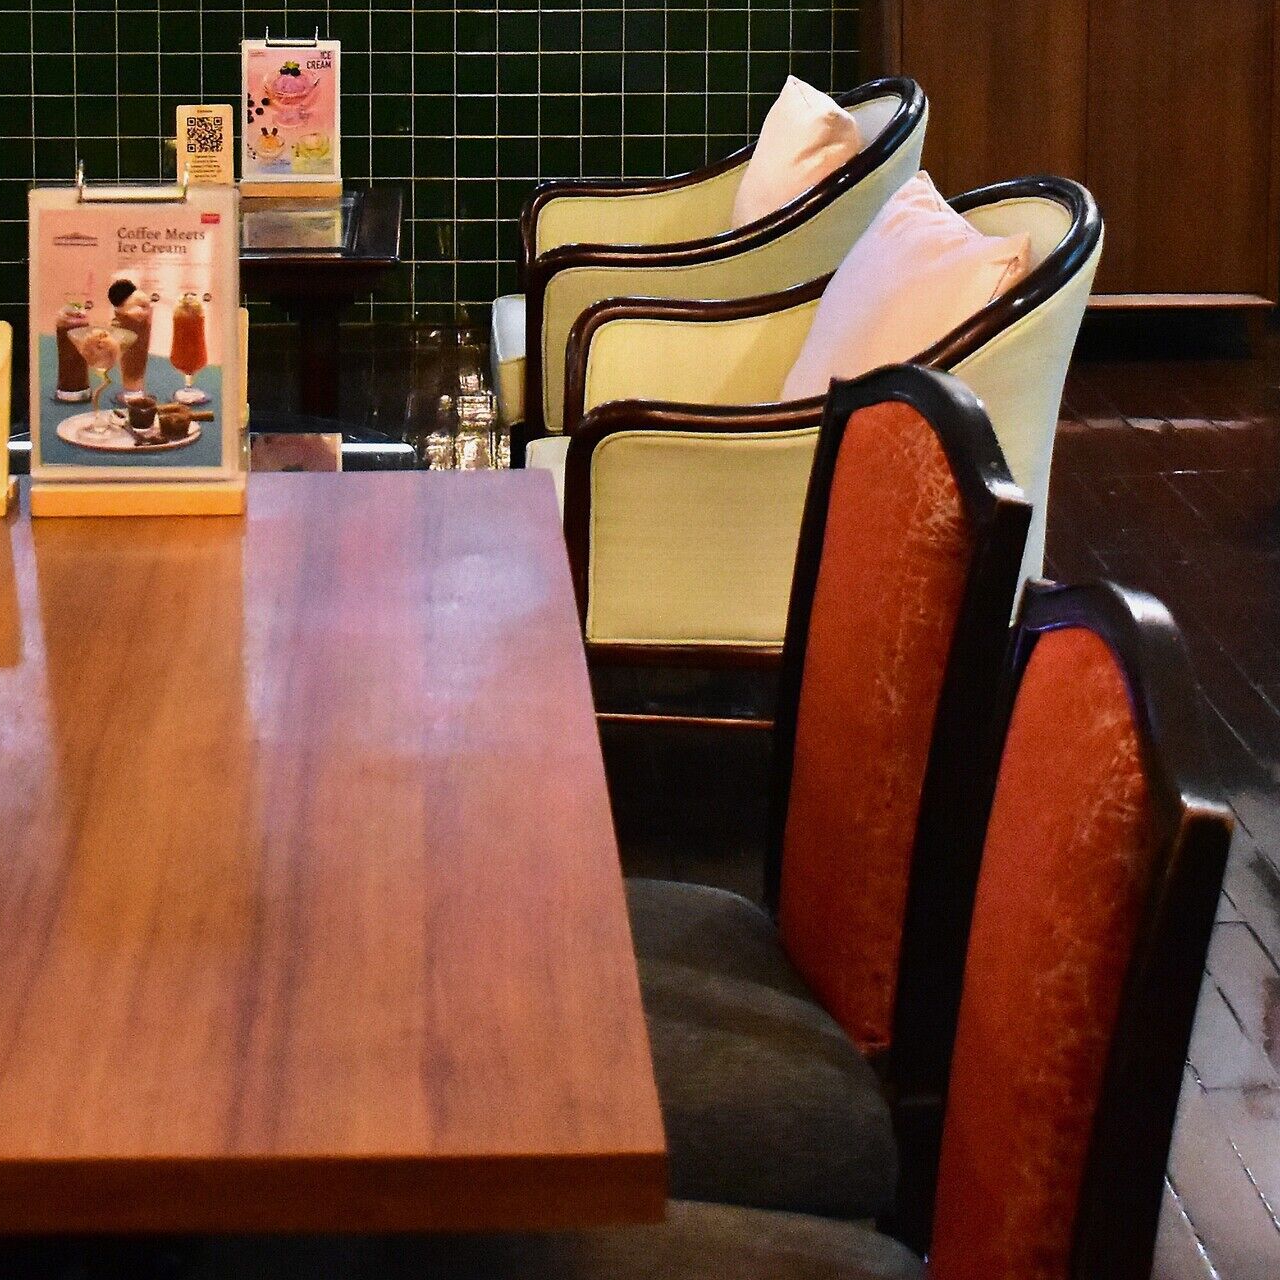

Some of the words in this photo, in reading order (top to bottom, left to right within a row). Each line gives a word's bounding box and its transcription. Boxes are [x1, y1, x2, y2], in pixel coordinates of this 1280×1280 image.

[320, 50, 332, 60] ICE
[306, 60, 332, 70] CREAM
[117, 227, 162, 241] Coffee
[165, 228, 205, 241] Meets
[117, 242, 138, 254] Ice
[141, 242, 187, 254] Cream
